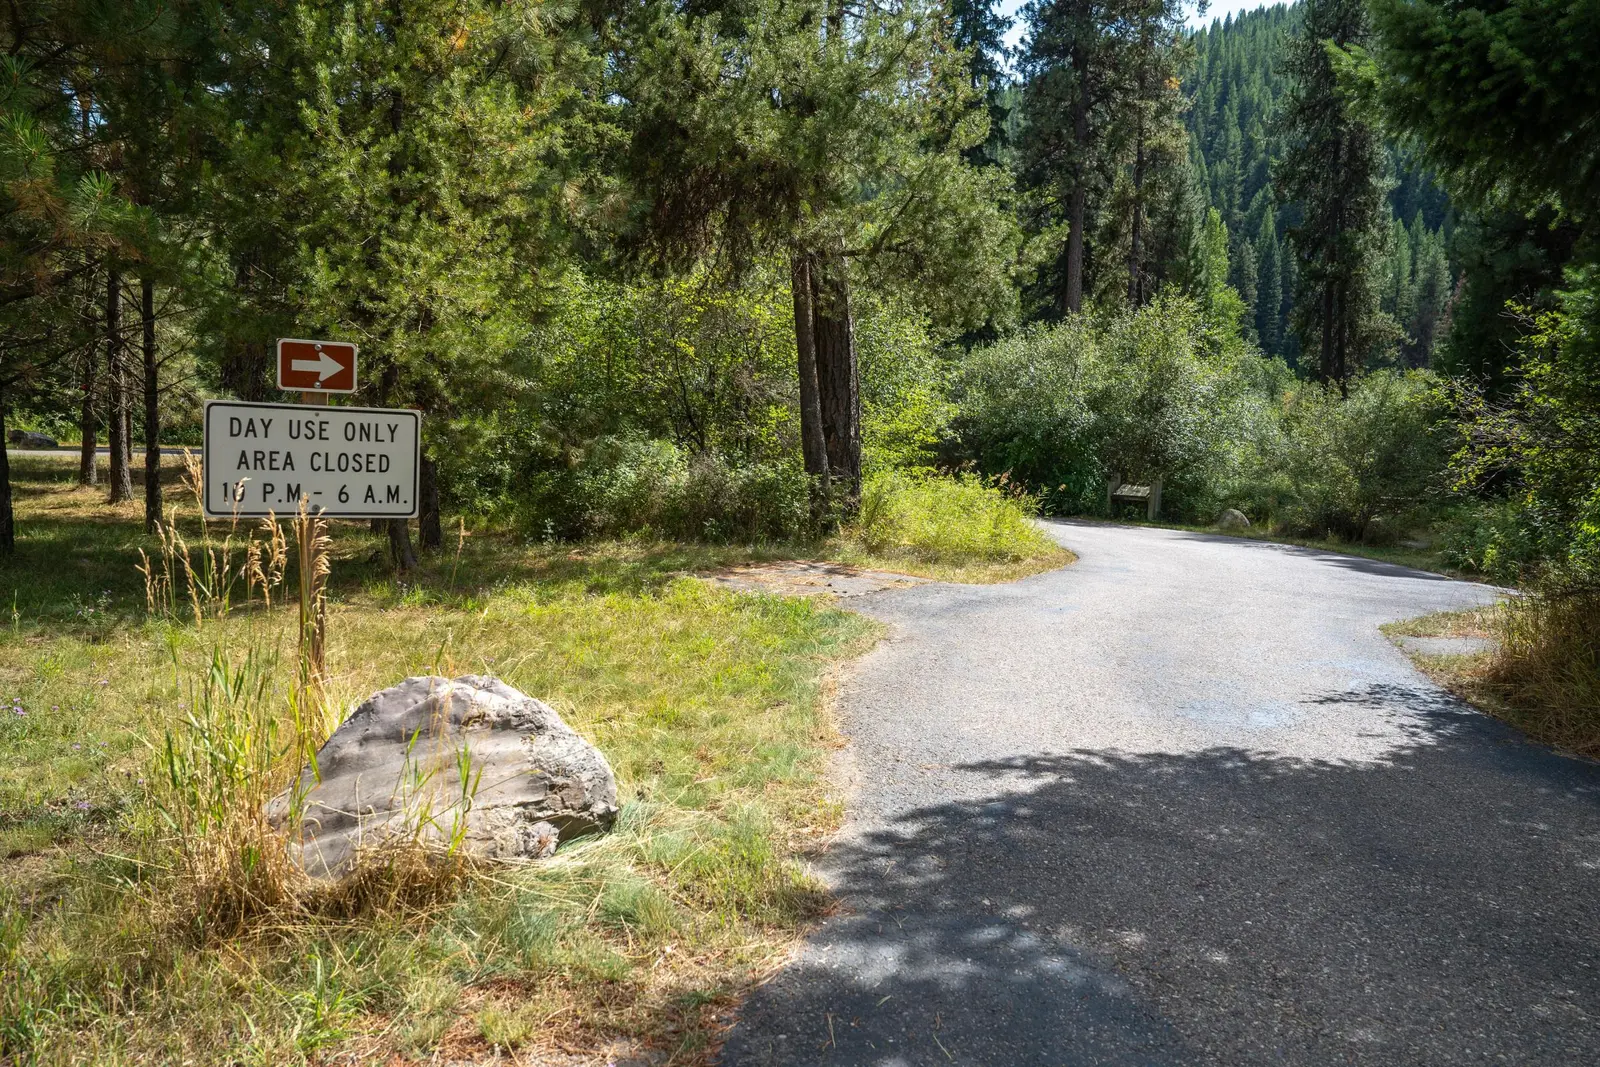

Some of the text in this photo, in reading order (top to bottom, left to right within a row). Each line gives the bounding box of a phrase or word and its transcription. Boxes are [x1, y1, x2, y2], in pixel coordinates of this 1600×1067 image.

[229, 417, 399, 443] DAY USE ONLY
[236, 450, 390, 473] AREA CLOSED
[222, 482, 246, 503] 10
[338, 484, 350, 504] 6
[363, 484, 408, 504] A.M.
